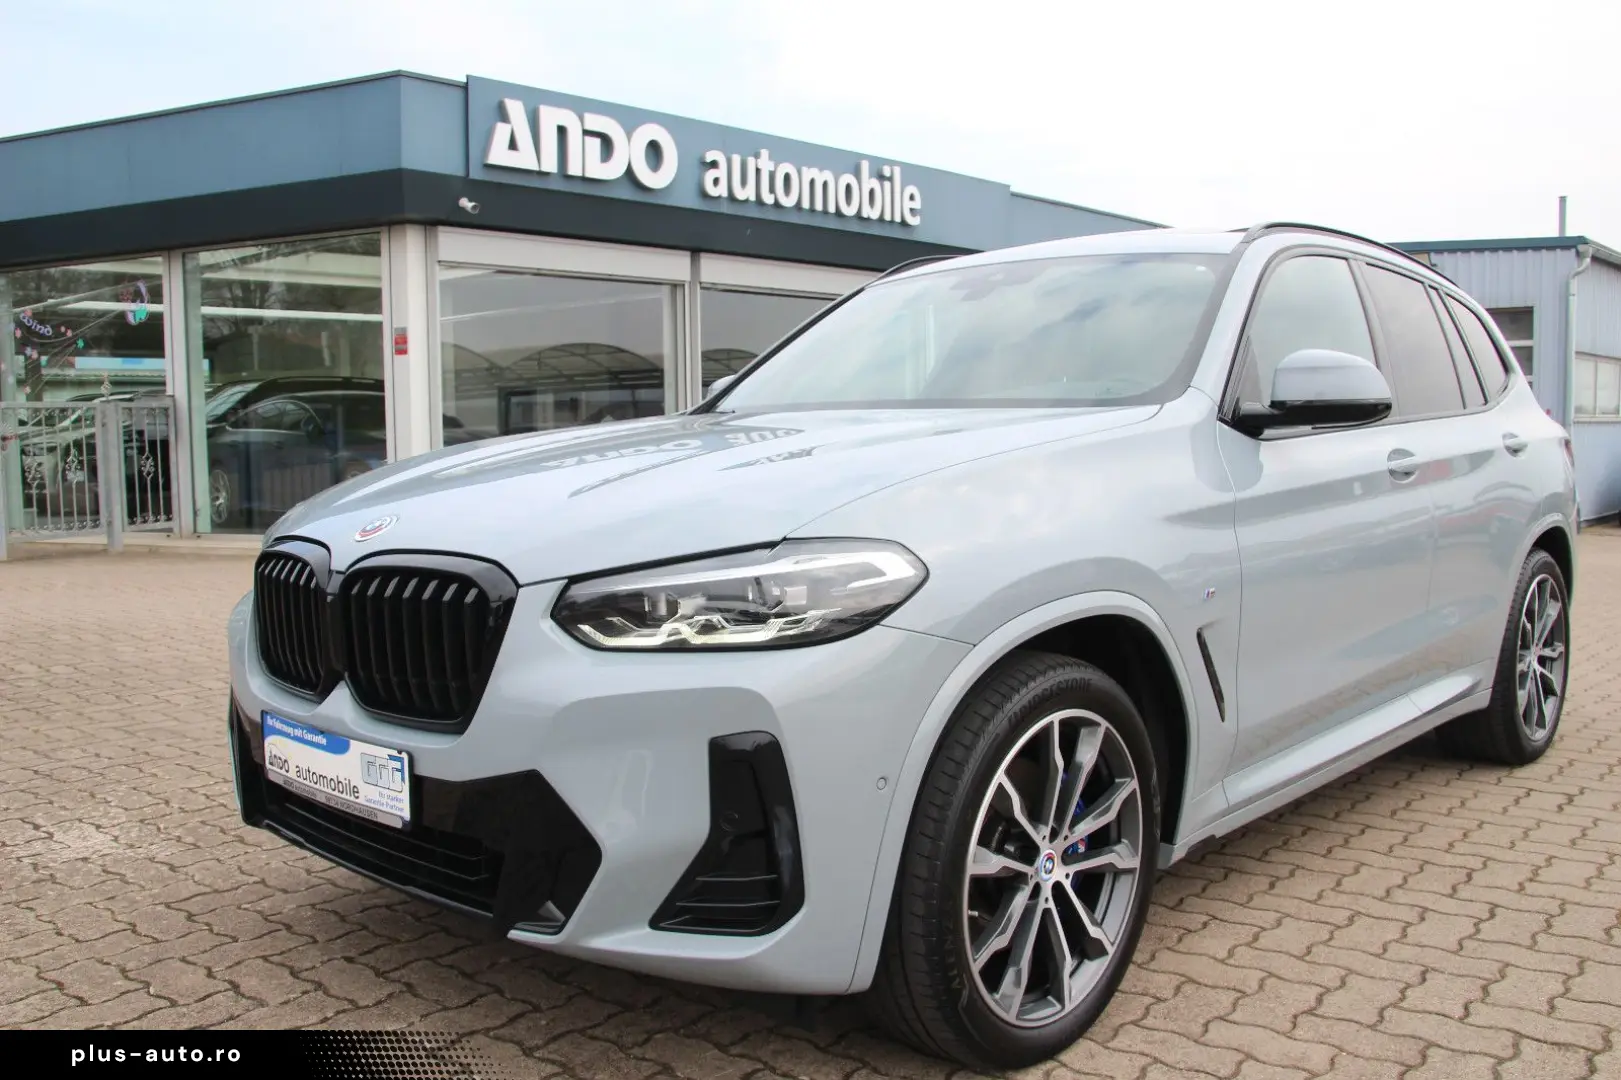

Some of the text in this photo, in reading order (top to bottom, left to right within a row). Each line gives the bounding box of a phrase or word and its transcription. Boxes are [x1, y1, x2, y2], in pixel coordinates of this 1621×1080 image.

[484, 98, 921, 226] ANDO automobile
[303, 729, 327, 746] Garantie
[295, 764, 360, 799] automobile
